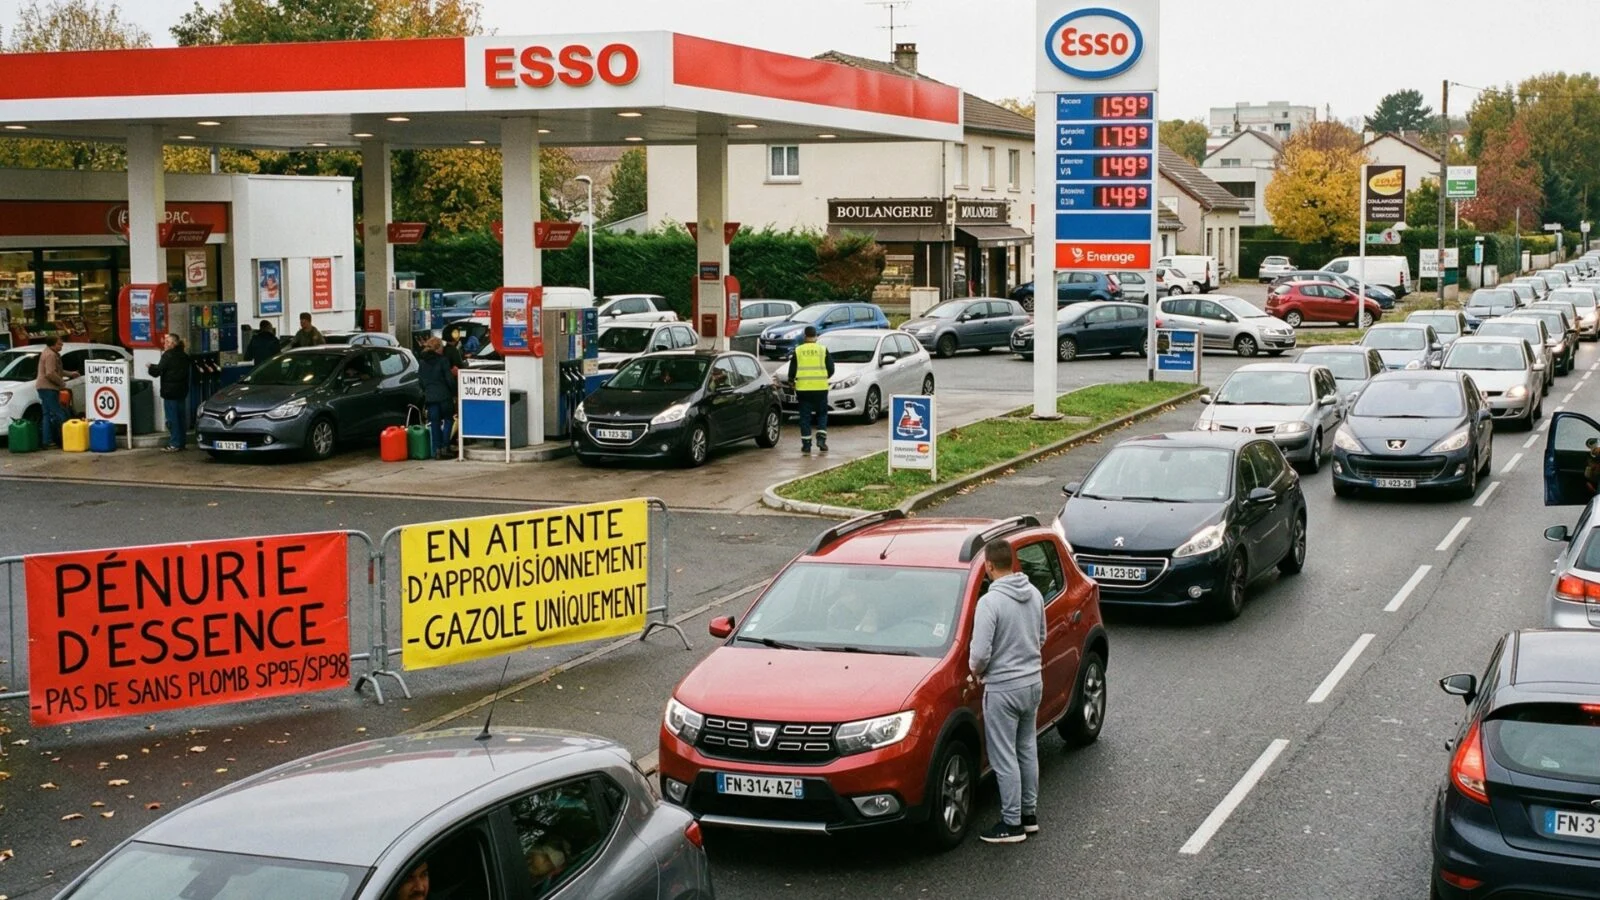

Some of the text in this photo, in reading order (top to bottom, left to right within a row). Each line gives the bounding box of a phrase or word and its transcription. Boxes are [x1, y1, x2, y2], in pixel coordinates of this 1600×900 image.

[485, 43, 640, 88] ESSO
[837, 206, 933, 218] BOULANGERIE
[89, 366, 124, 374] LIMITATION
[90, 376, 123, 384] 30L/PERS
[462, 376, 504, 386] LIMITATION
[99, 396, 115, 410] 30
[427, 508, 623, 563] EN ATTENTE
[58, 602, 326, 675] D'ESSENCE
[94, 681, 120, 709] DE
[128, 674, 182, 705] SANS
[189, 665, 249, 697] PLOMB
[256, 652, 349, 688] SP95/SP98
